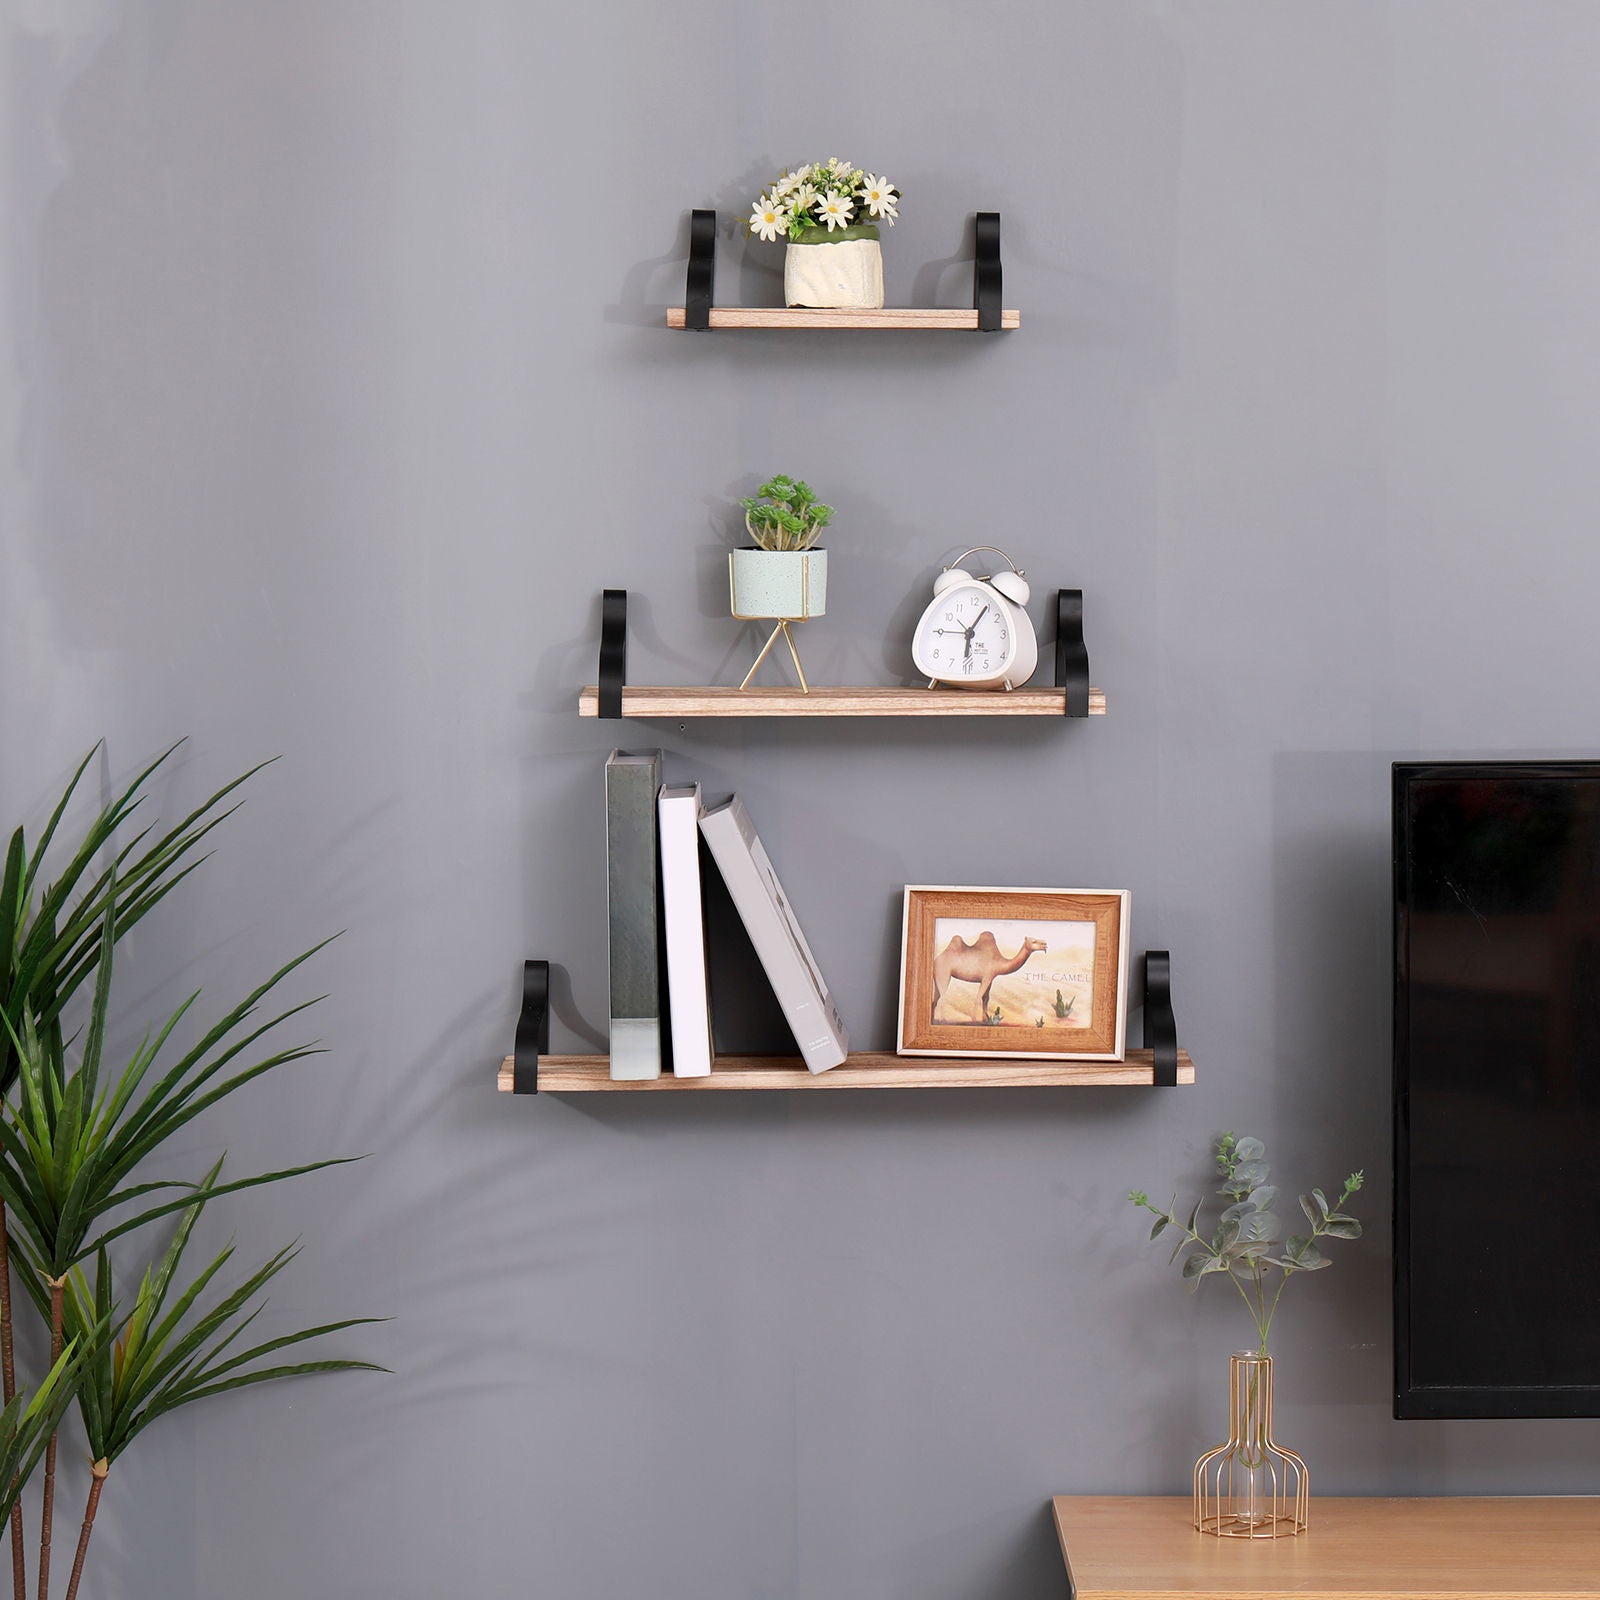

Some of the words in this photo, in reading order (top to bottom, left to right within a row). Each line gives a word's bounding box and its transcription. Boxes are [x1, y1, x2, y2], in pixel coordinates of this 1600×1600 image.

[970, 597, 980, 607] 12
[956, 603, 963, 613] 11
[945, 612, 954, 622] 10
[994, 613, 1001, 624] 2
[1000, 629, 1007, 640] 3
[933, 648, 940, 659] 8
[1000, 651, 1006, 660] 4
[949, 658, 955, 668] 7
[982, 659, 989, 670] 5
[1024, 973, 1048, 982] THE
[1052, 973, 1091, 983] CAMEL
